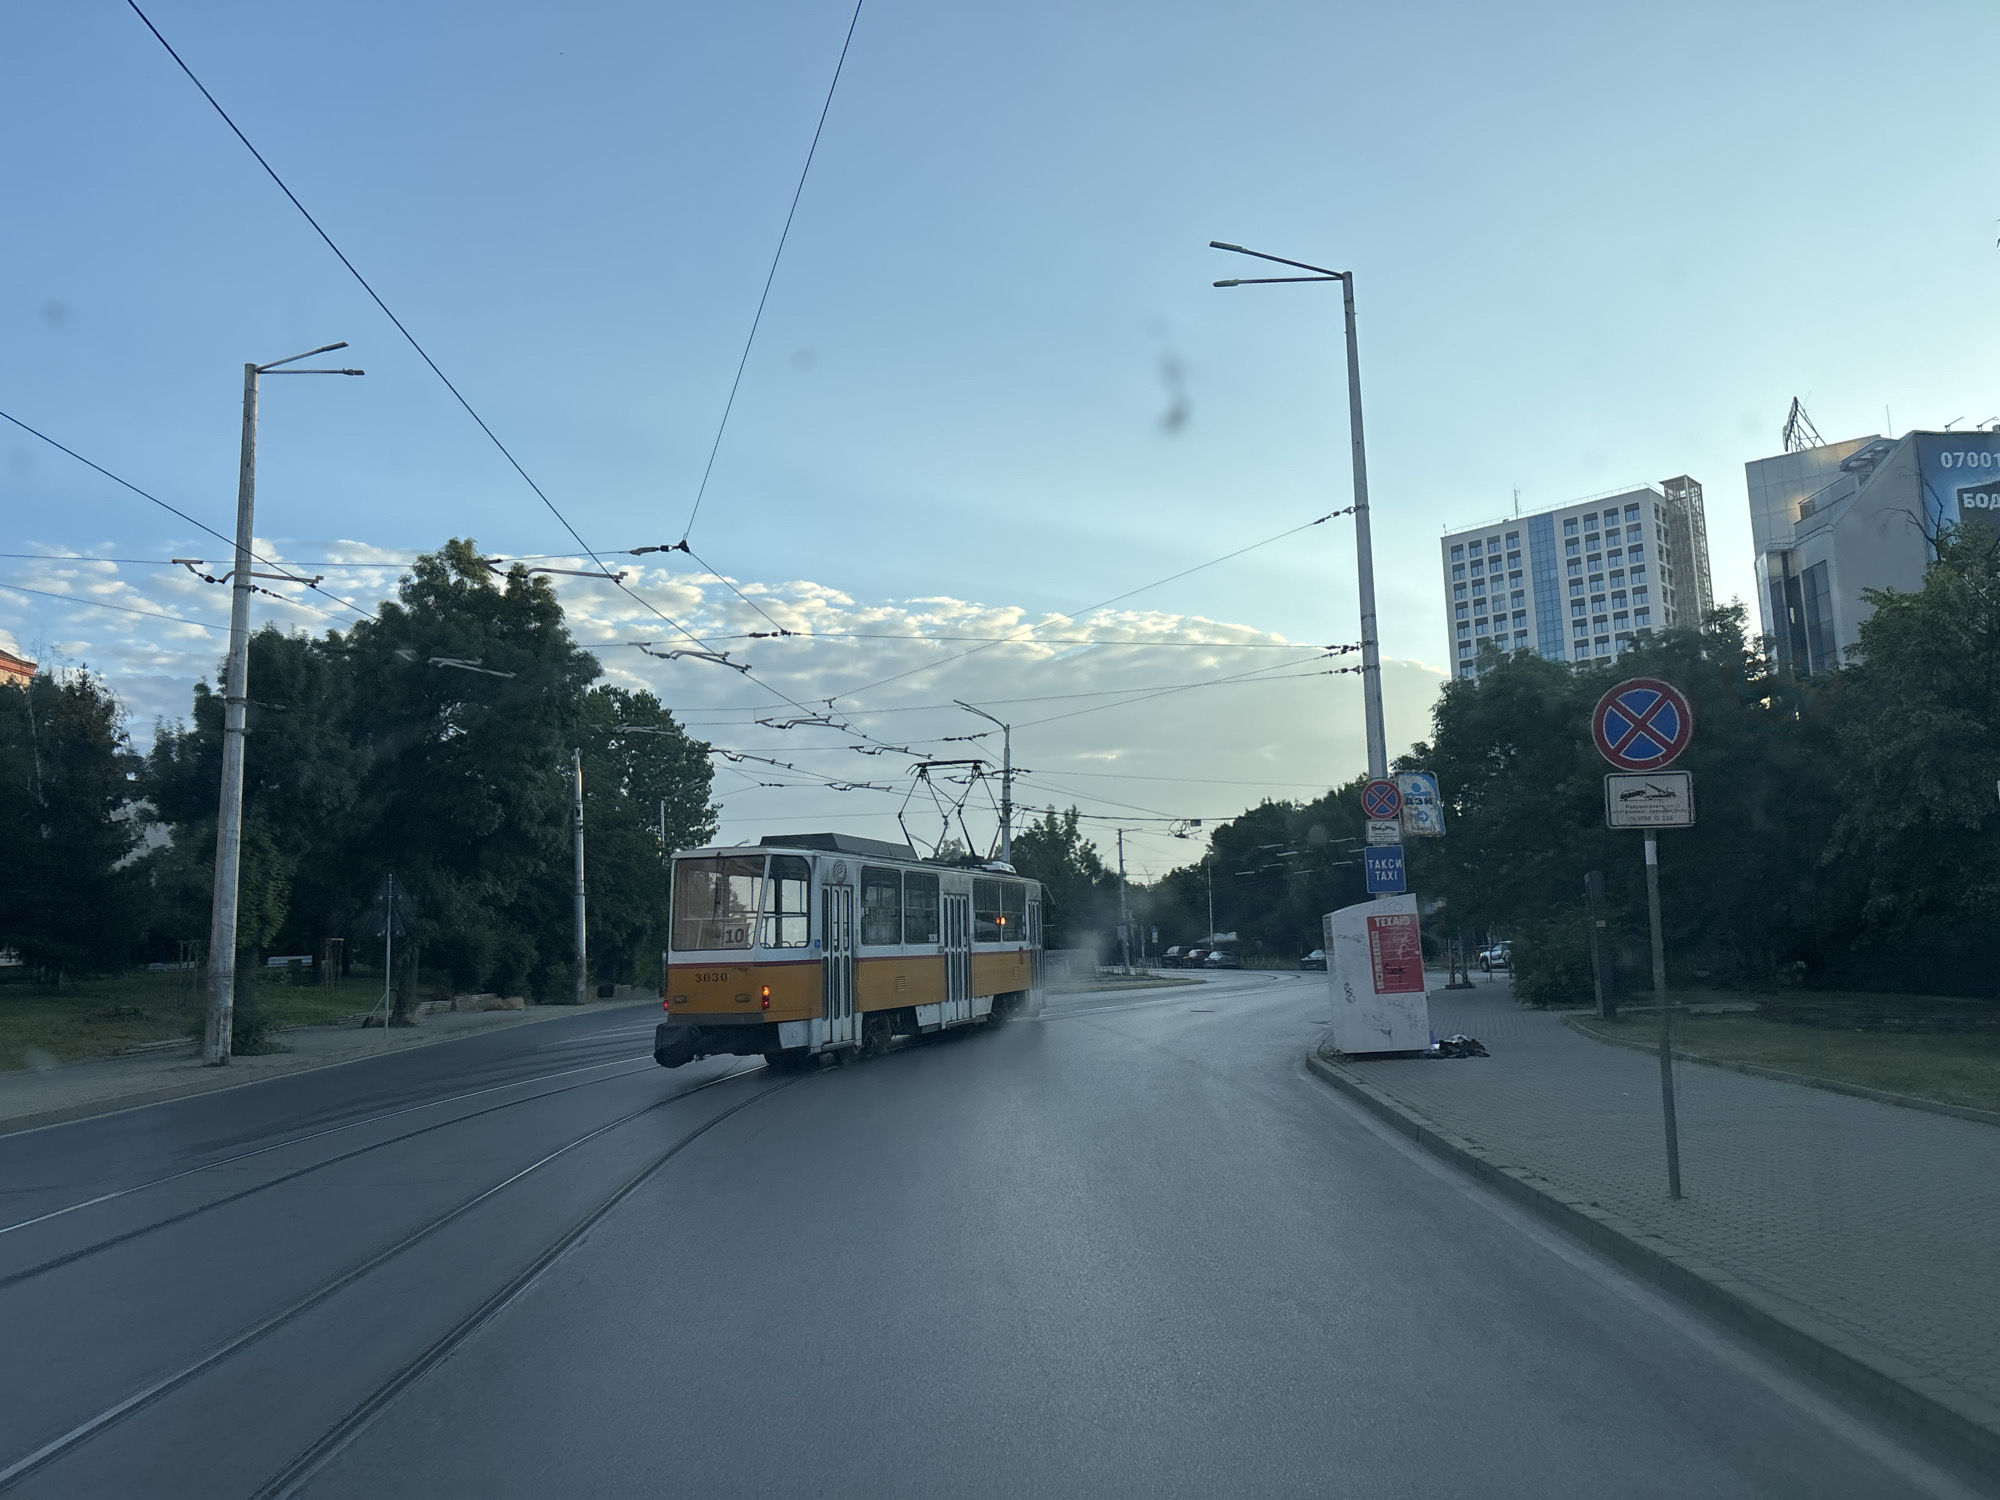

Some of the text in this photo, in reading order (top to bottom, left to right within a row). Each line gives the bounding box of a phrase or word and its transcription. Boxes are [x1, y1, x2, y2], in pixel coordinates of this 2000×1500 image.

[1405, 797, 1433, 806] ДЗИ
[1368, 858, 1402, 869] ТАКСИ
[1375, 870, 1398, 881] TAXI
[1374, 915, 1411, 927] TEXAID
[725, 928, 745, 944] 10
[695, 972, 728, 983] 3030
